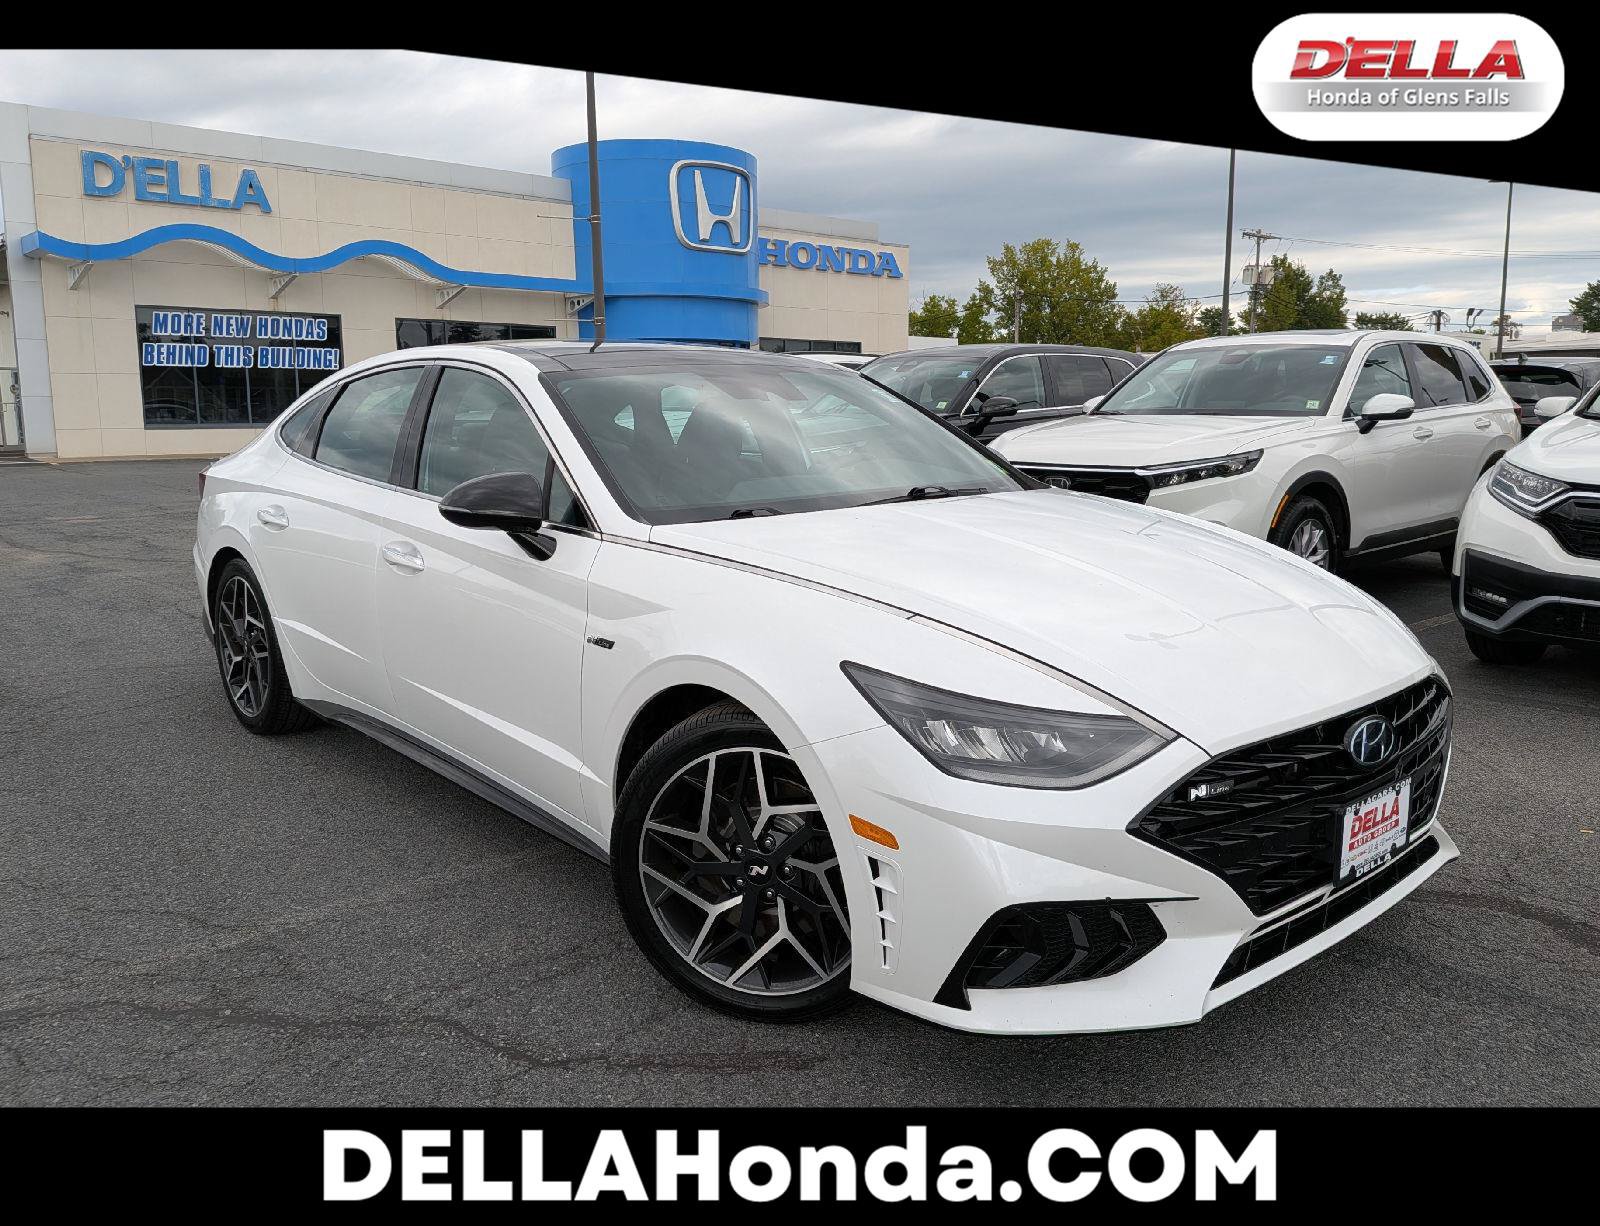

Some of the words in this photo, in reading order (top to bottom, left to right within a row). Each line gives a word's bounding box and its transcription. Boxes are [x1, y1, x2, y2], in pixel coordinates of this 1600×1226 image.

[81, 150, 272, 214] D'ELLA
[759, 237, 903, 279] HONDA
[152, 311, 205, 337] MORE
[211, 314, 252, 338] NEW
[257, 316, 328, 341] HONDAS
[143, 343, 209, 367] BEHIND
[214, 345, 254, 368] THIS
[258, 346, 340, 370] BUILDING!
[1350, 796, 1400, 840] DELLA
[1353, 834, 1372, 849] AUTO
[1373, 821, 1397, 837] GROUP
[1356, 852, 1392, 878] DELLA
